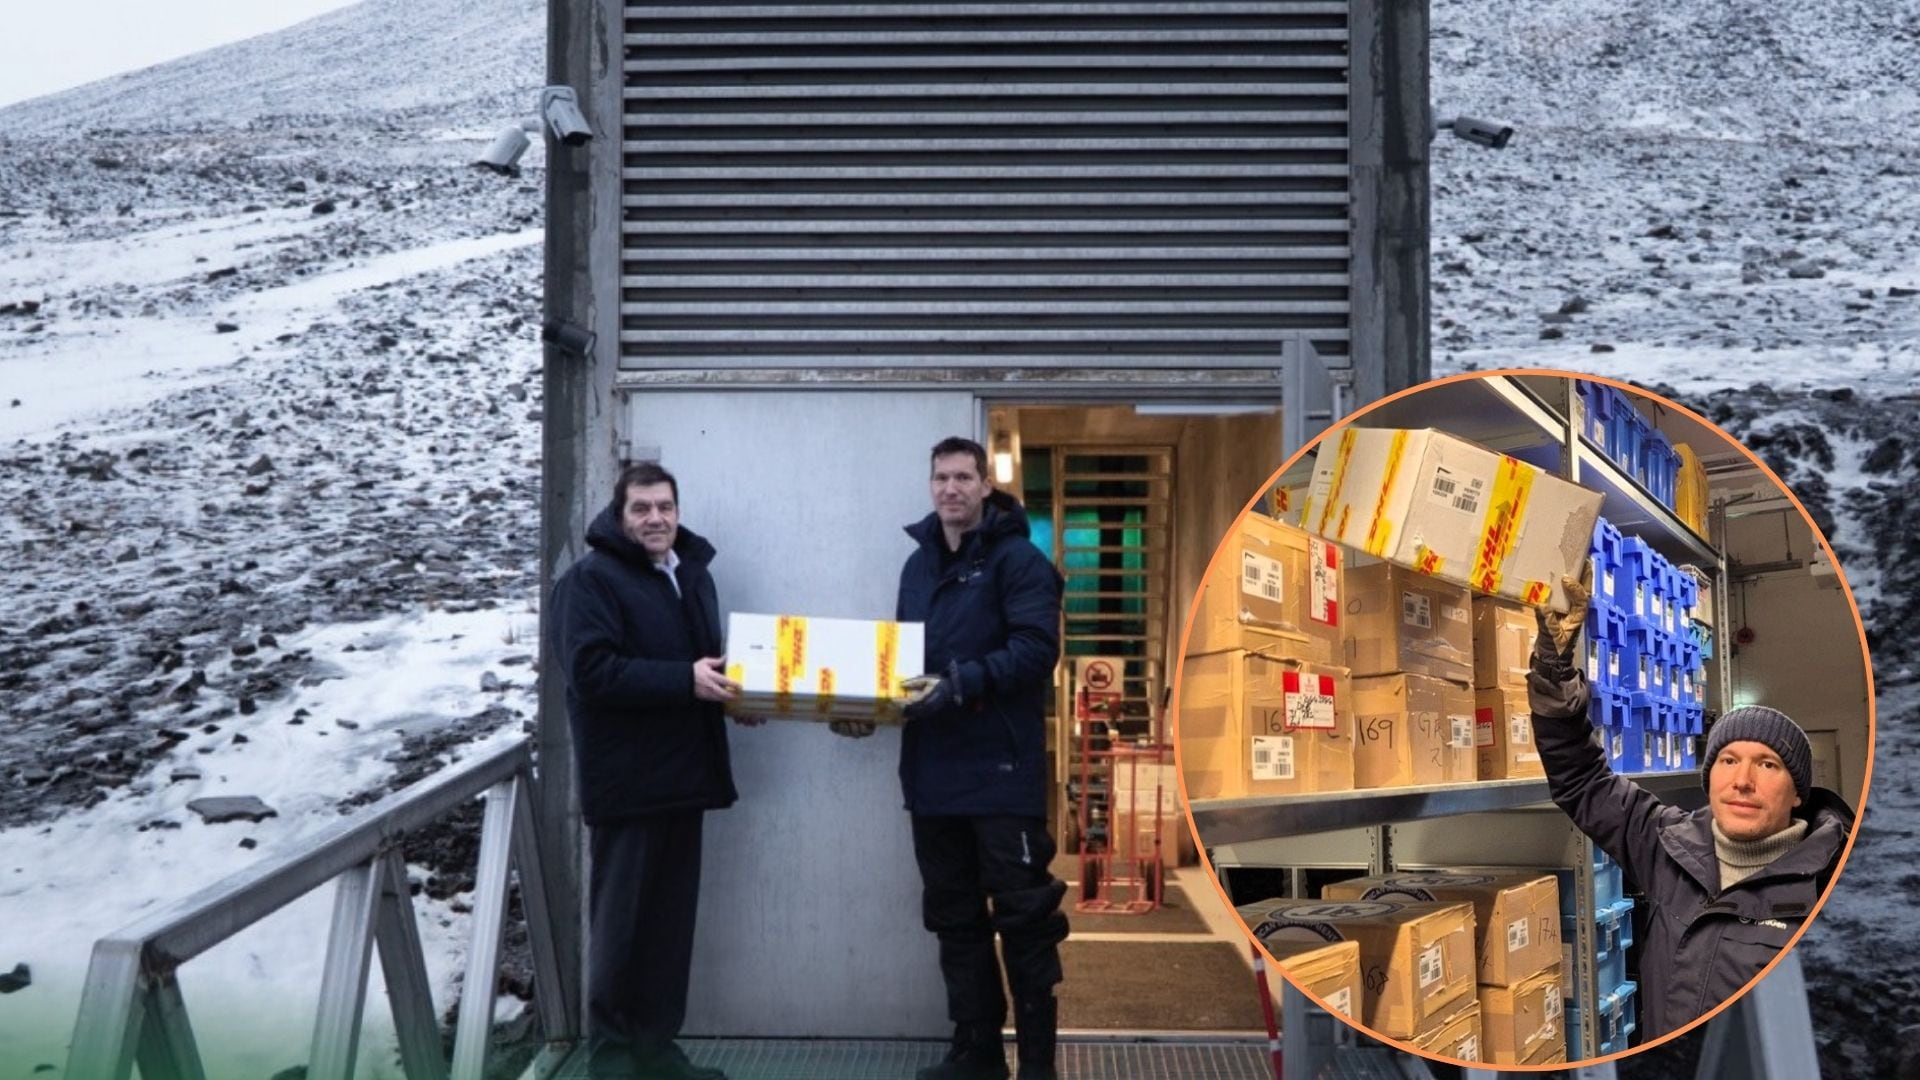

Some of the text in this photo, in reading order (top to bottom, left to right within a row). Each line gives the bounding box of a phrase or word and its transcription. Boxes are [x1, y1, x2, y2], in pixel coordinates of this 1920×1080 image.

[1264, 709, 1296, 735] 16
[1359, 717, 1394, 749] 169
[1538, 917, 1557, 947] 174
